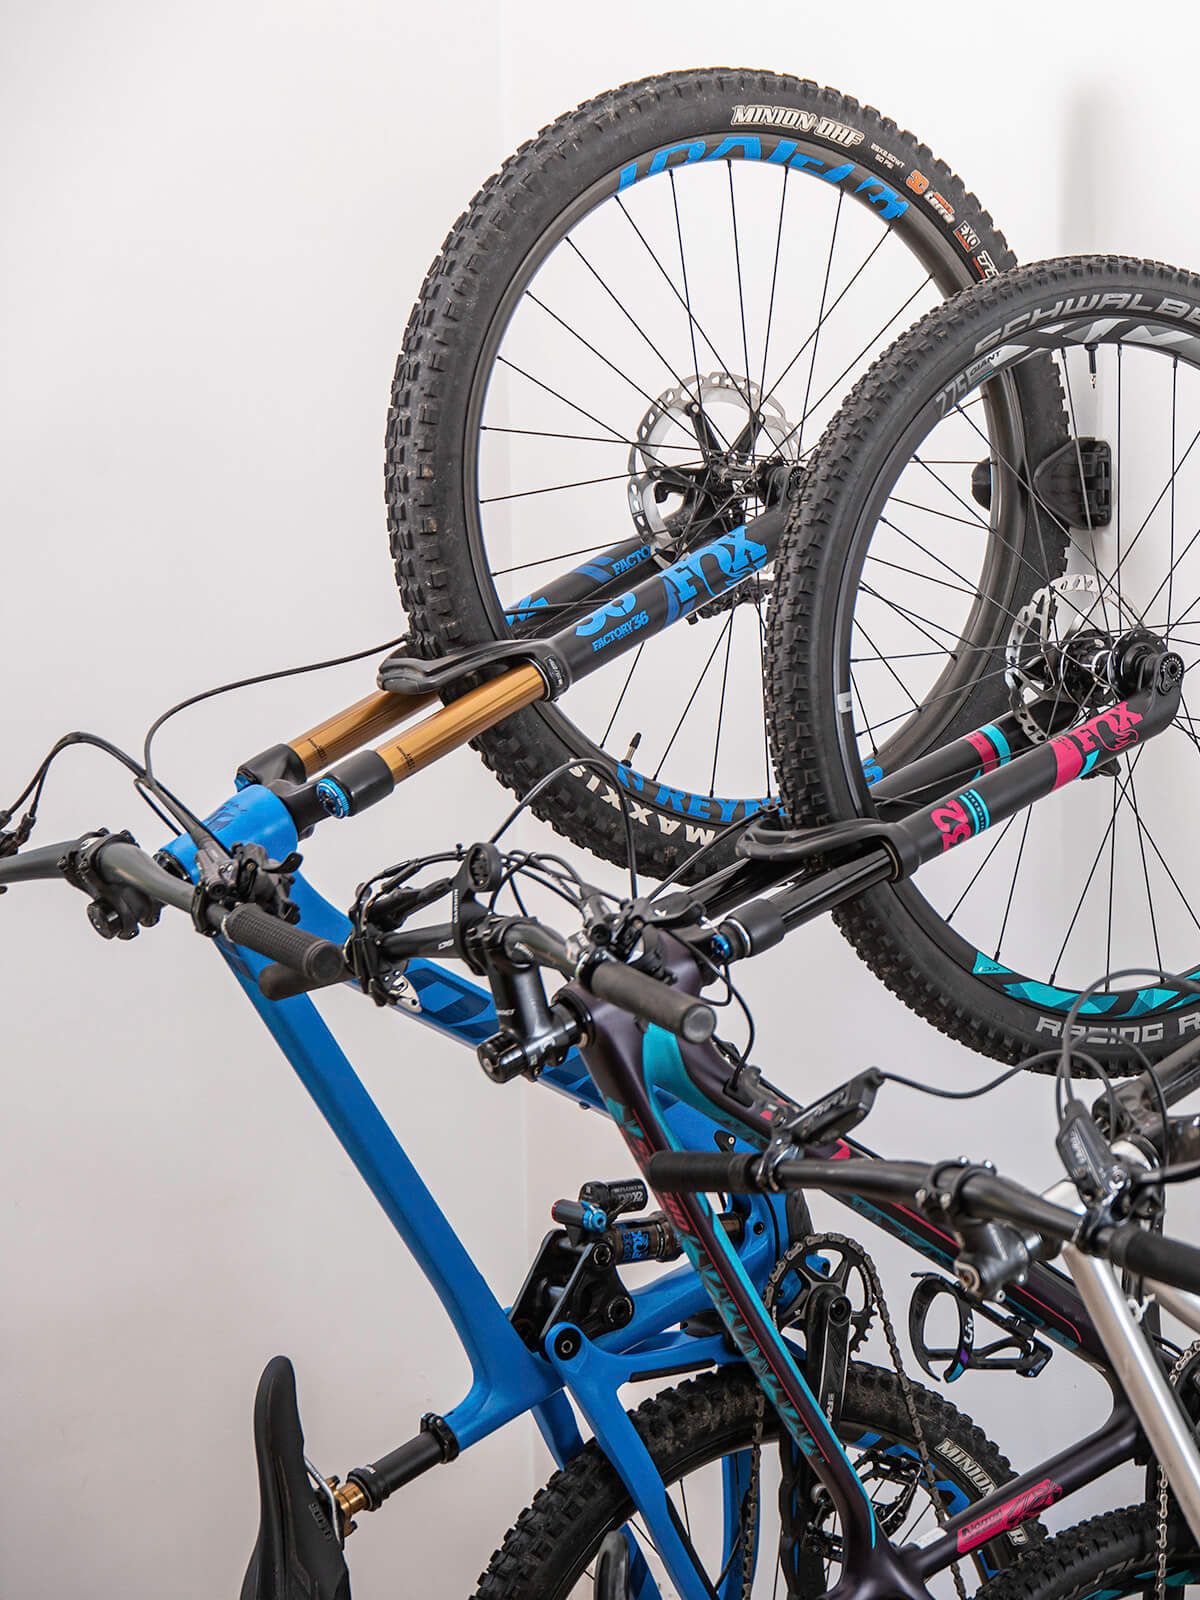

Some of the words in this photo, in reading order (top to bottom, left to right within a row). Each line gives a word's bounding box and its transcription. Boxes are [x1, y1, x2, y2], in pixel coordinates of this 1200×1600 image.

[731, 105, 817, 131] MINION
[813, 115, 865, 147] DHF
[969, 351, 1001, 377] GIANT
[668, 525, 767, 606] FOX
[592, 618, 633, 652] FACTORY
[1078, 701, 1144, 751] FOX
[568, 753, 716, 847] MAXXIS
[1035, 1015, 1164, 1044] RACING
[934, 1437, 999, 1498] MINION
